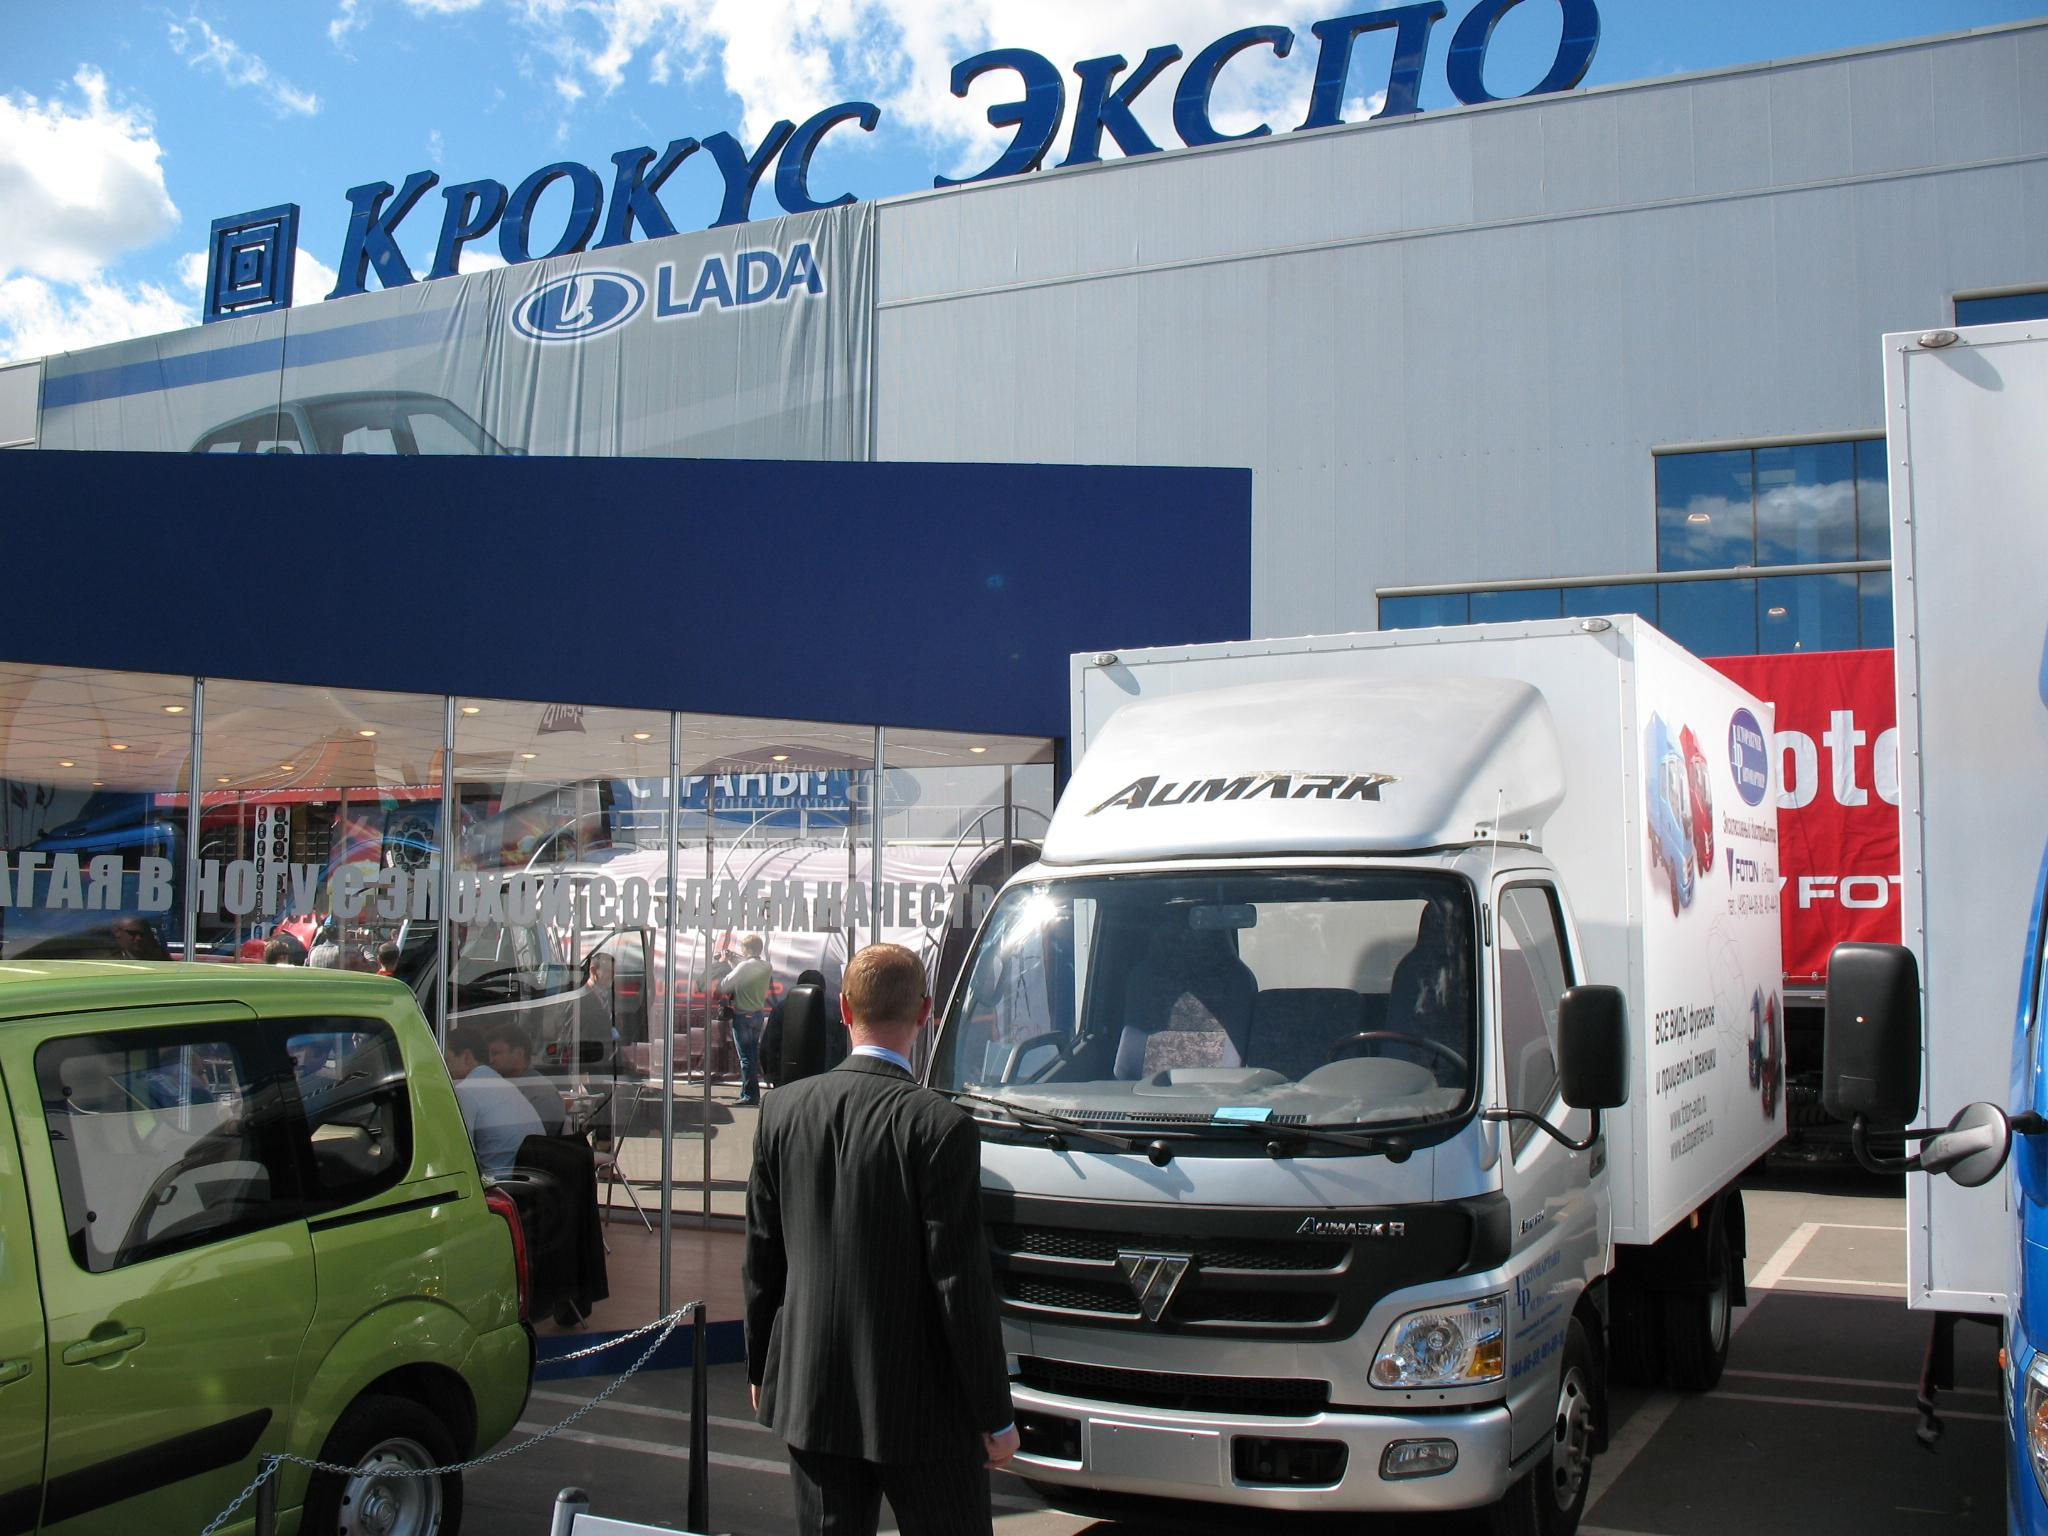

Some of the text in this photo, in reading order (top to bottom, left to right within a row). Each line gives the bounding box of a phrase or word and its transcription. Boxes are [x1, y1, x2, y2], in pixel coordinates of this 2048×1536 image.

[326, 0, 1601, 299] КРОКУС ЭКСПО
[657, 242, 824, 318] LADA
[1083, 773, 1399, 817] AUMARK
[137, 856, 173, 911] В
[187, 859, 321, 917] НОГУ
[331, 863, 363, 918] С
[1798, 875, 1901, 908] FO
[1655, 1010, 1669, 1045] ВСЕ
[1670, 1006, 1688, 1045] ВИДЫ
[1296, 1216, 1385, 1236] AUMARK
